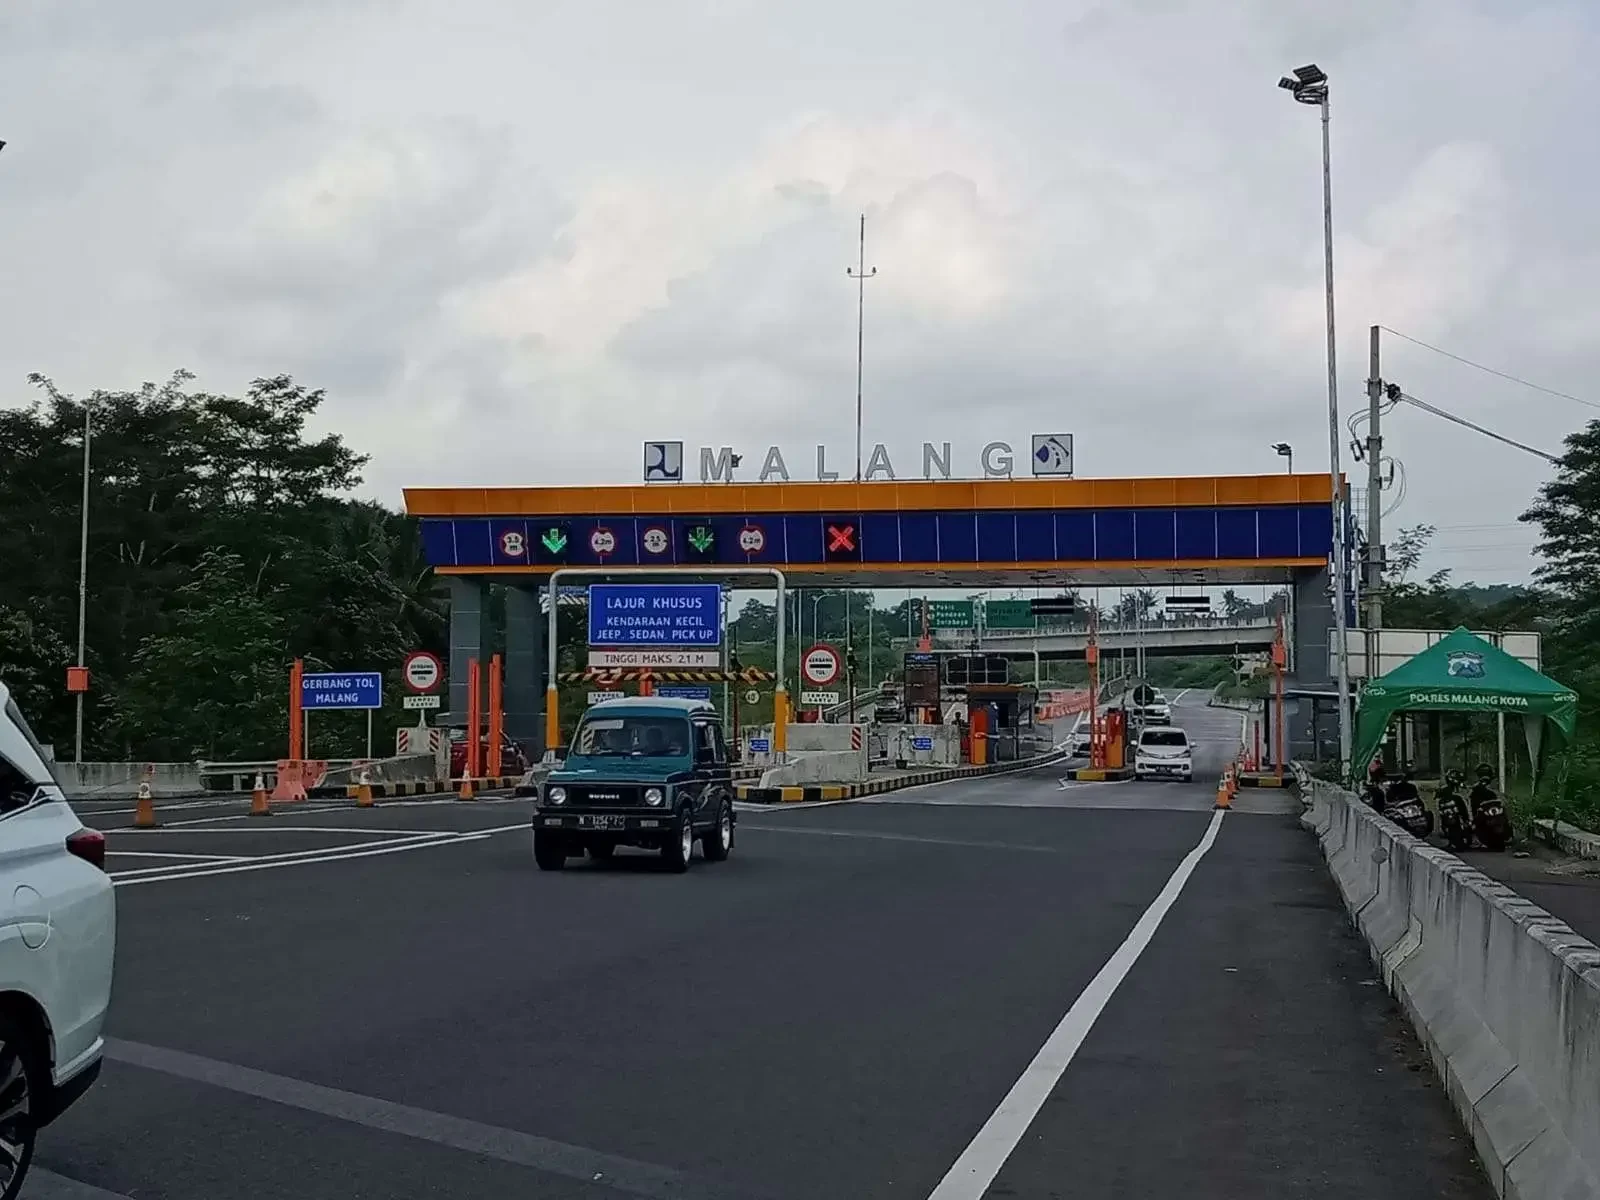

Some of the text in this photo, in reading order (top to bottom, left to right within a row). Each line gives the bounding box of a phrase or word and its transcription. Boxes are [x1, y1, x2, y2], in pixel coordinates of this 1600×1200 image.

[699, 442, 1014, 479] MALANG
[607, 597, 702, 609] LAJUR KHUSUS
[606, 615, 705, 626] KENDARAAN KECIL
[672, 629, 696, 640] PICK
[699, 629, 714, 639] UP
[604, 654, 638, 664] TINGGI
[642, 654, 673, 664] MAKS
[695, 654, 704, 664] M
[302, 677, 375, 689] GERBANG TOL
[1363, 687, 1386, 696] Grab
[315, 693, 359, 704] MALANG
[1409, 693, 1529, 707] POLRES MALANG KOTA
[1553, 693, 1576, 703] Grab
